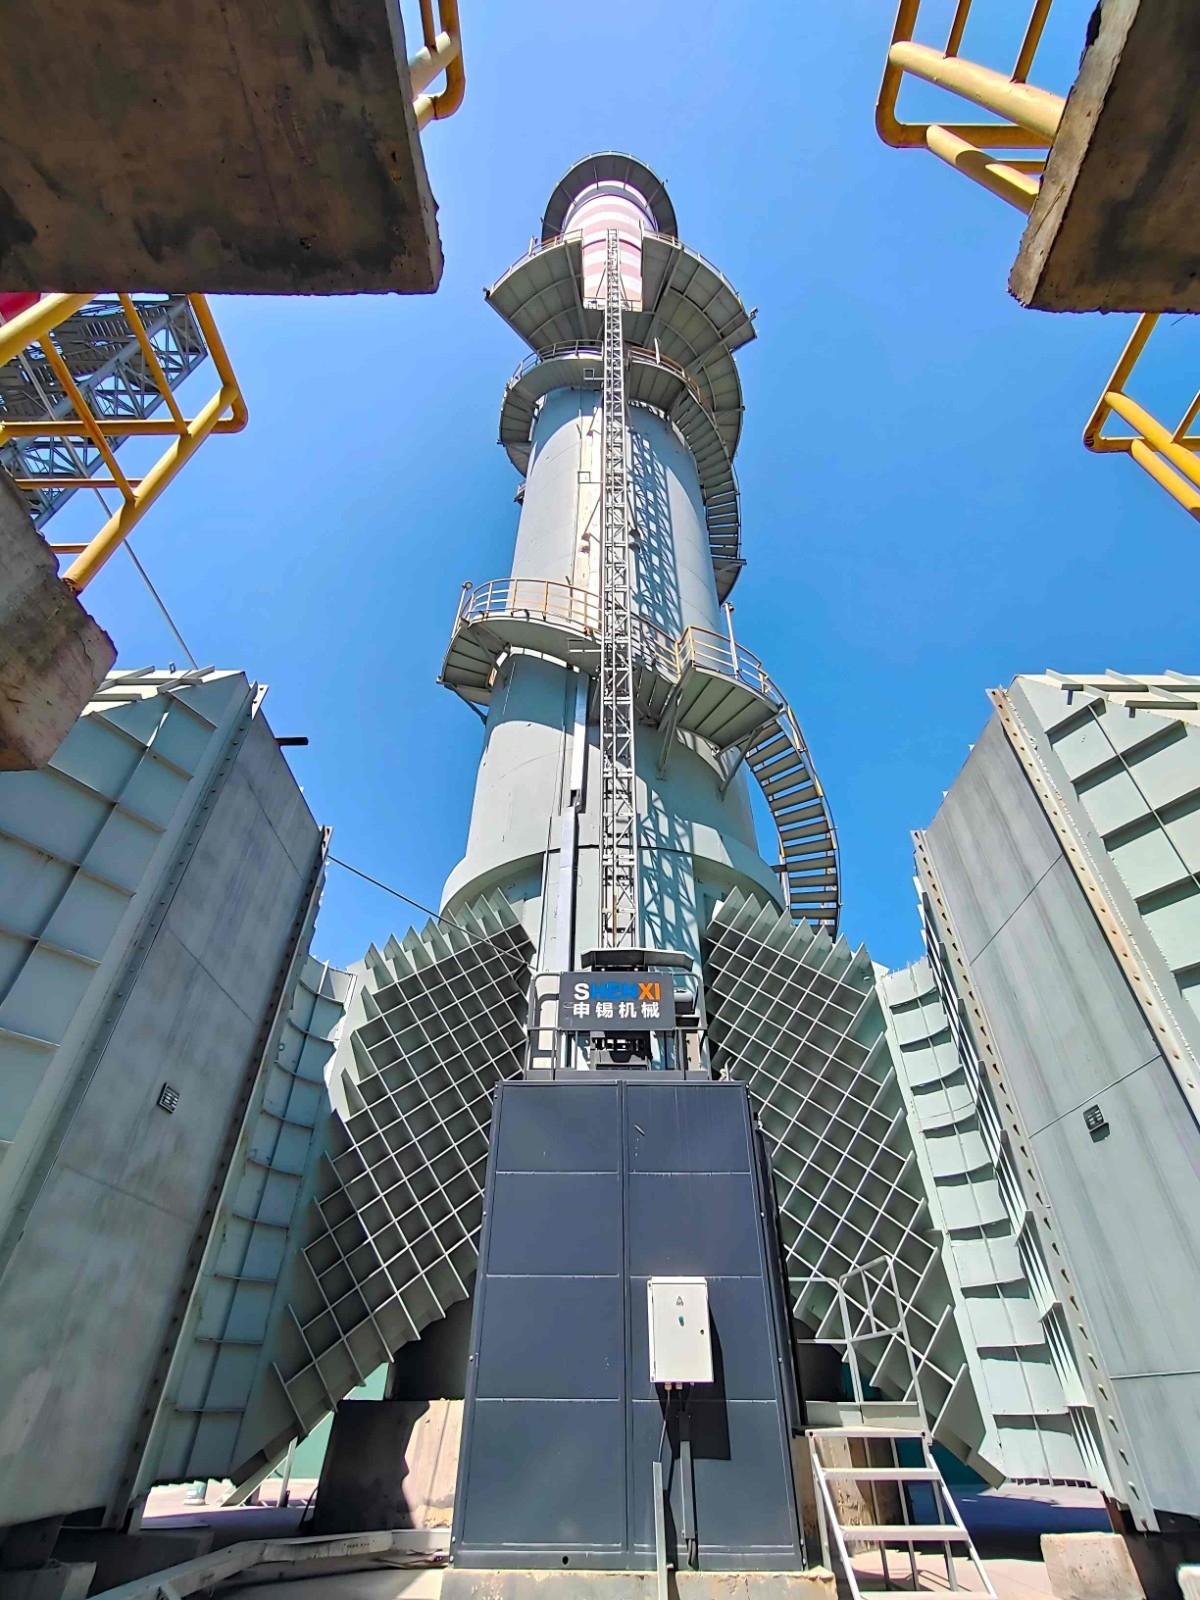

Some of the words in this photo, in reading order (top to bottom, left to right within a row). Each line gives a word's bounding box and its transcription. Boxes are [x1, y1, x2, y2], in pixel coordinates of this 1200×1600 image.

[574, 982, 661, 1001] SHENXI
[573, 1002, 660, 1018] 申锡机械
